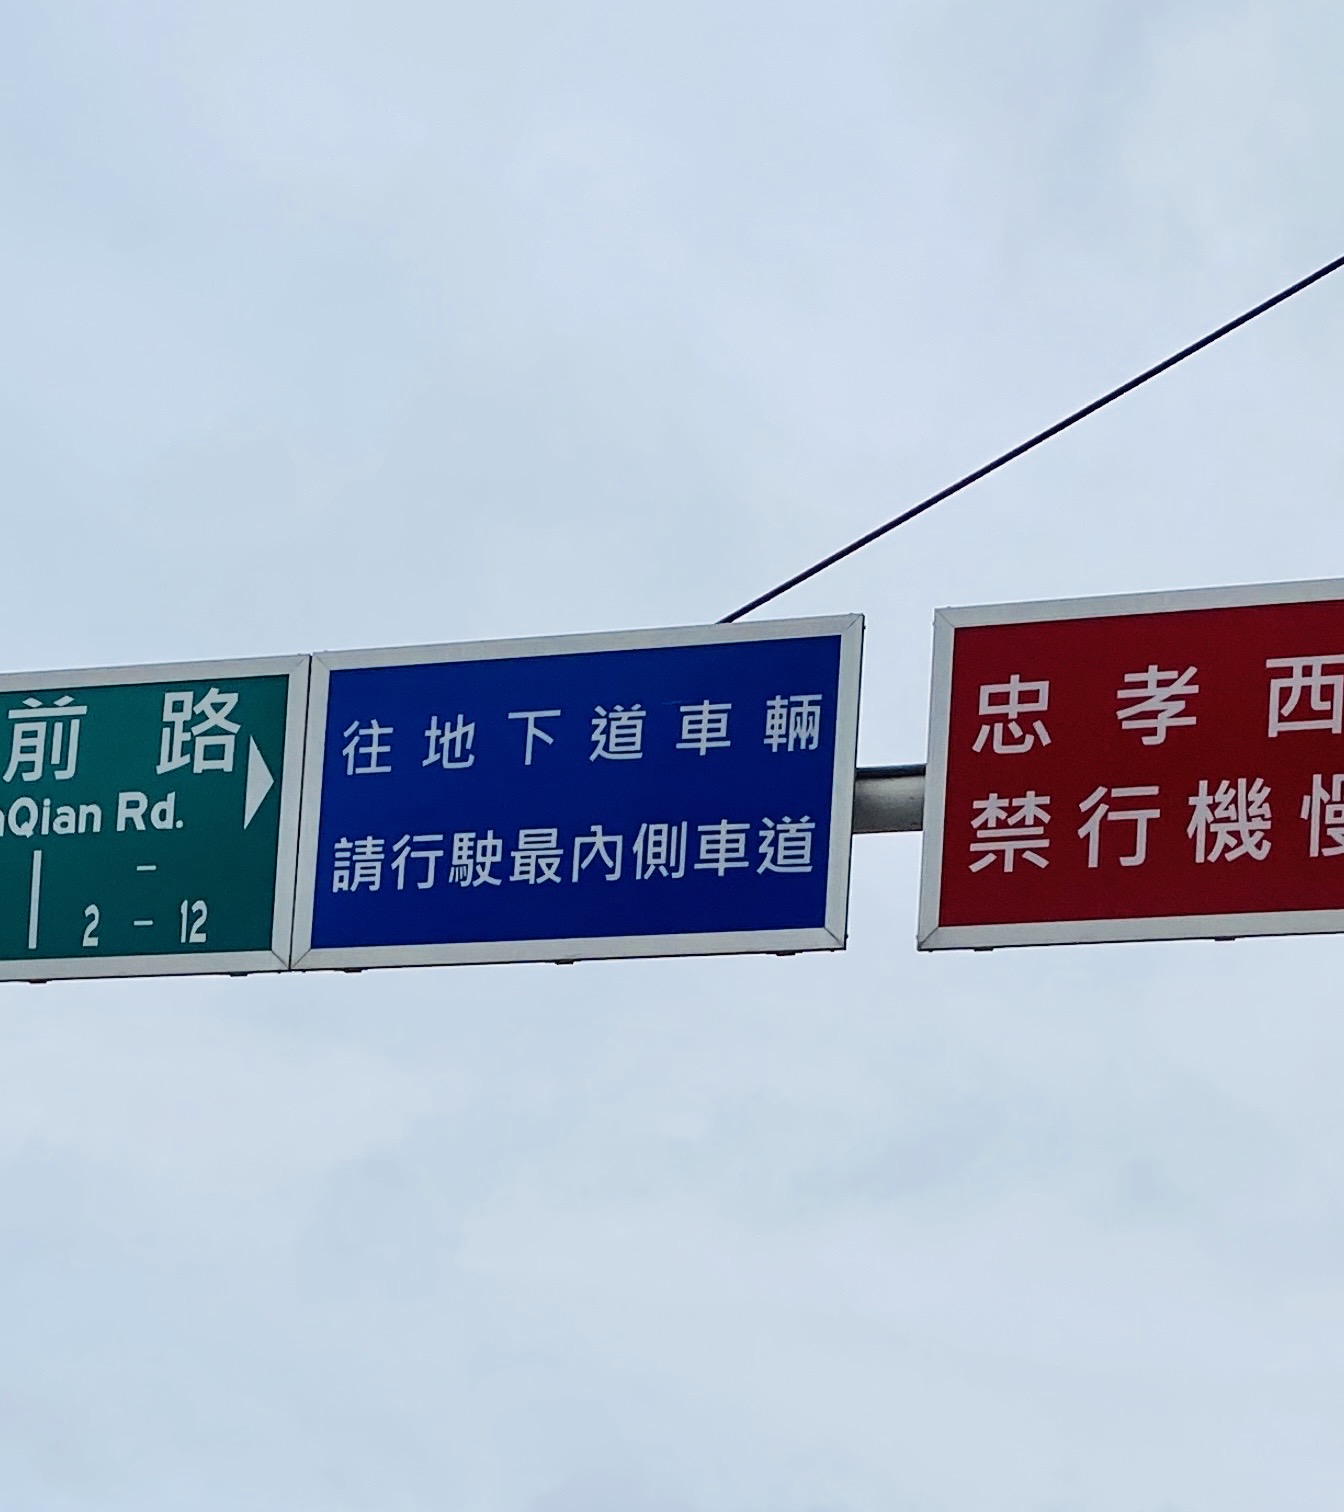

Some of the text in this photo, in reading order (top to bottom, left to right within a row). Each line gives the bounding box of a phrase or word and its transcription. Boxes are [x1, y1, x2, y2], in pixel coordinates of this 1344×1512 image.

[340, 693, 823, 776] 往地下道車輛
[115, 790, 184, 833] Rd.
[331, 815, 814, 894] 請行駛最內側車道
